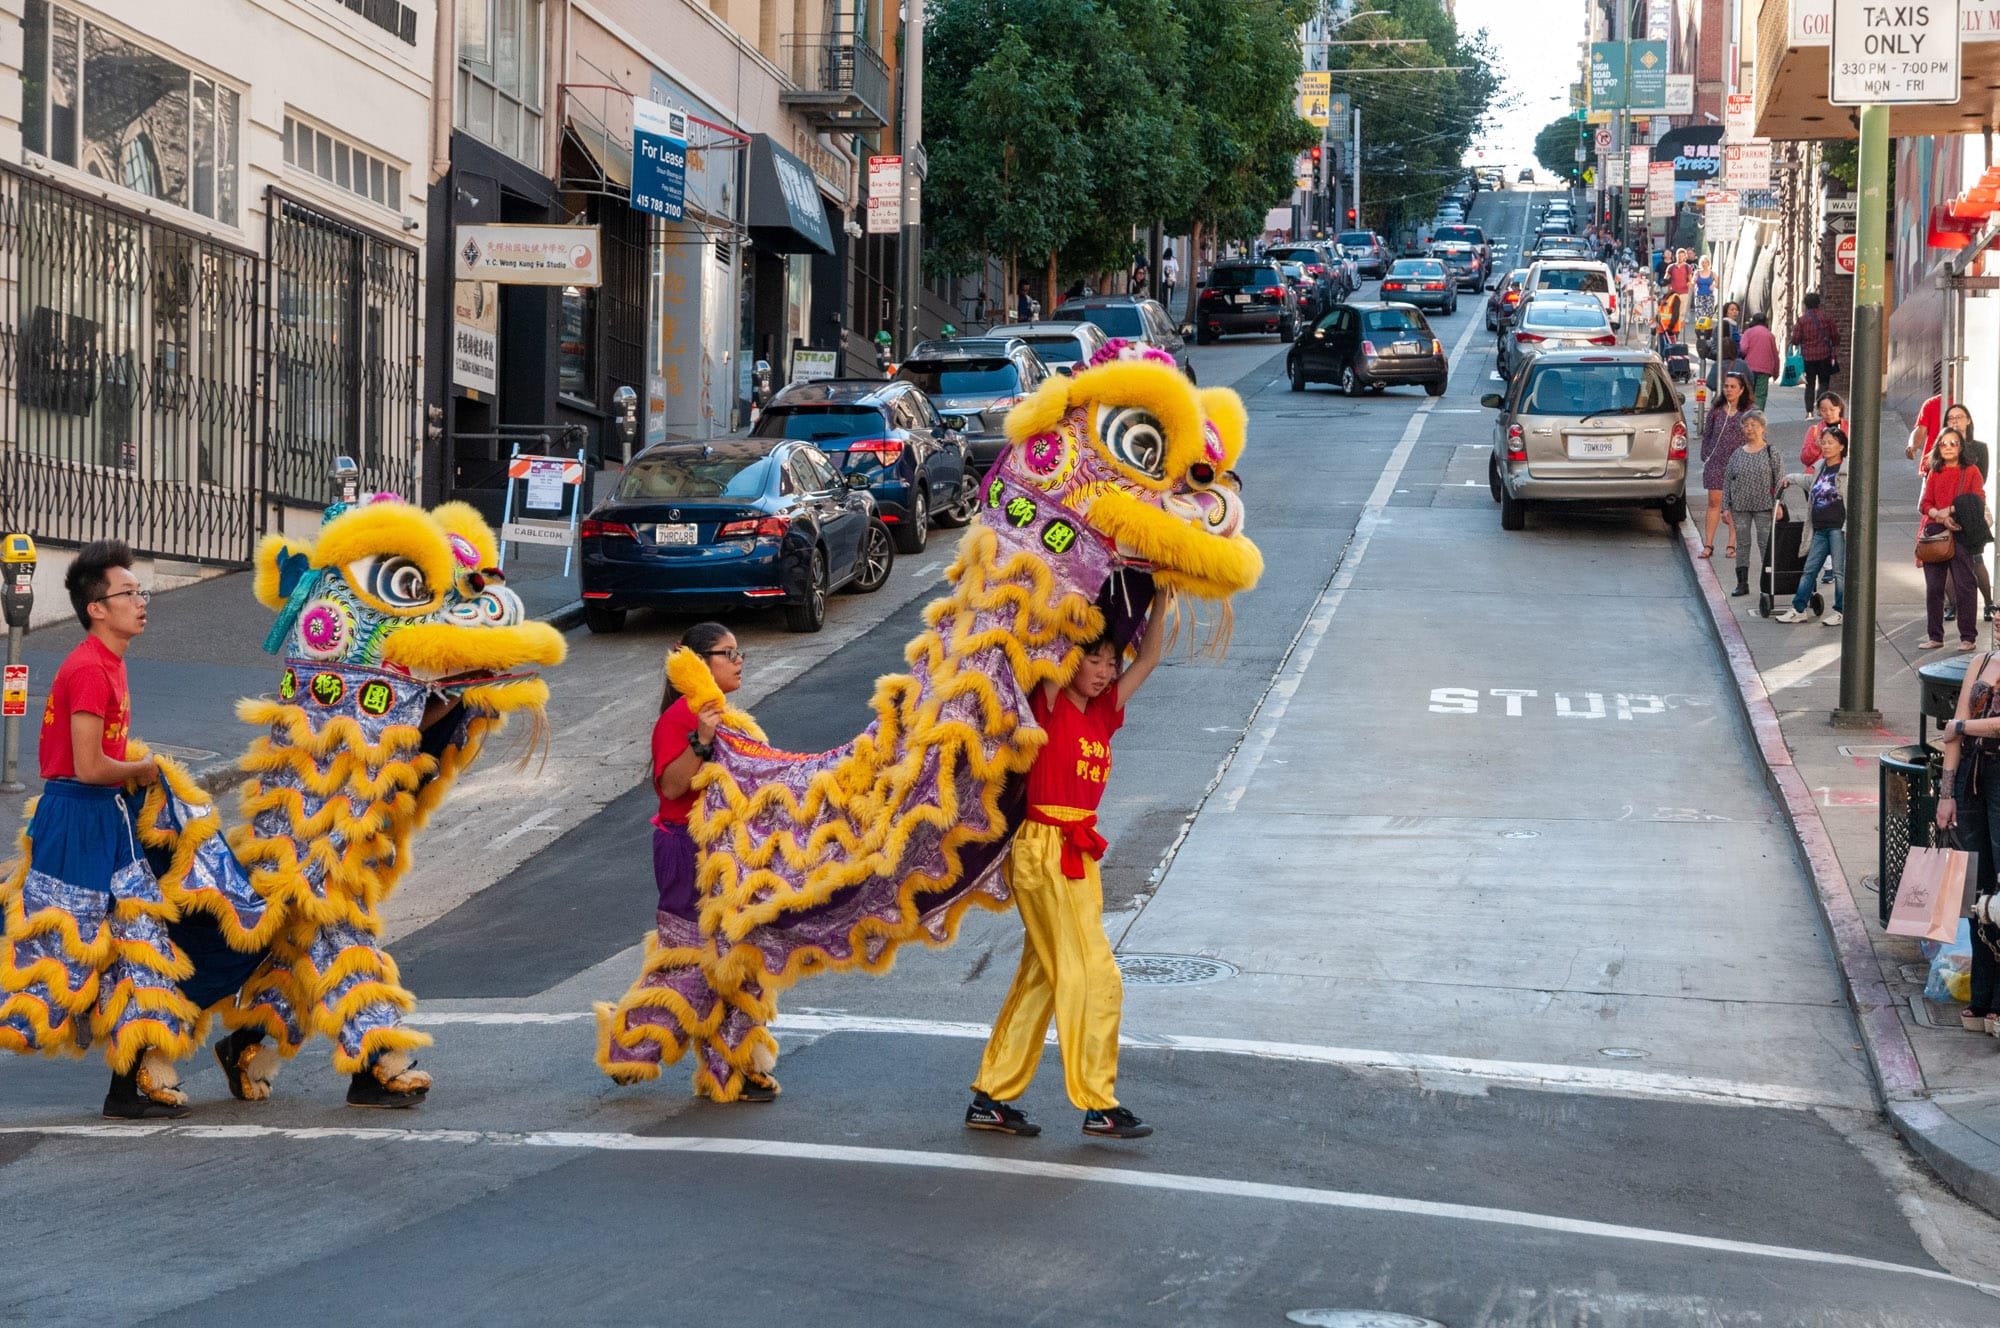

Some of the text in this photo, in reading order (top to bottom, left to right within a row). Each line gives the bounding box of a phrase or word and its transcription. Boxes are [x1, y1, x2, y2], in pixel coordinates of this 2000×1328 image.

[1863, 6, 1930, 28] TAXIS
[1864, 33, 1926, 54] ONLY
[1592, 63, 1609, 71] HIGH
[1841, 63, 1866, 75] 3:30
[1869, 63, 1886, 74] PM
[1902, 62, 1928, 74] 7:00
[1931, 62, 1948, 74] PM
[1592, 71, 1611, 79] ROAD
[1592, 79, 1602, 87] OR
[1864, 80, 1890, 92] MON
[1906, 79, 1925, 91] FRI
[1728, 103, 1741, 113] NO
[641, 139, 658, 159] For
[660, 144, 685, 169] Lease
[1728, 147, 1740, 159] NO
[1741, 151, 1769, 159] PARKING
[870, 163, 880, 172] NO
[1673, 156, 1719, 175] Pretty
[636, 193, 682, 218] 415 788 3100
[868, 198, 878, 208] NO
[1842, 242, 1852, 250] DO
[500, 260, 517, 268] Wong
[519, 261, 534, 269] Kung
[546, 261, 567, 269] Studio
[796, 351, 834, 363] STEAP
[514, 527, 563, 539] CABLECOM
[660, 531, 694, 541] 7HRC488
[1428, 686, 1666, 721] STOP
